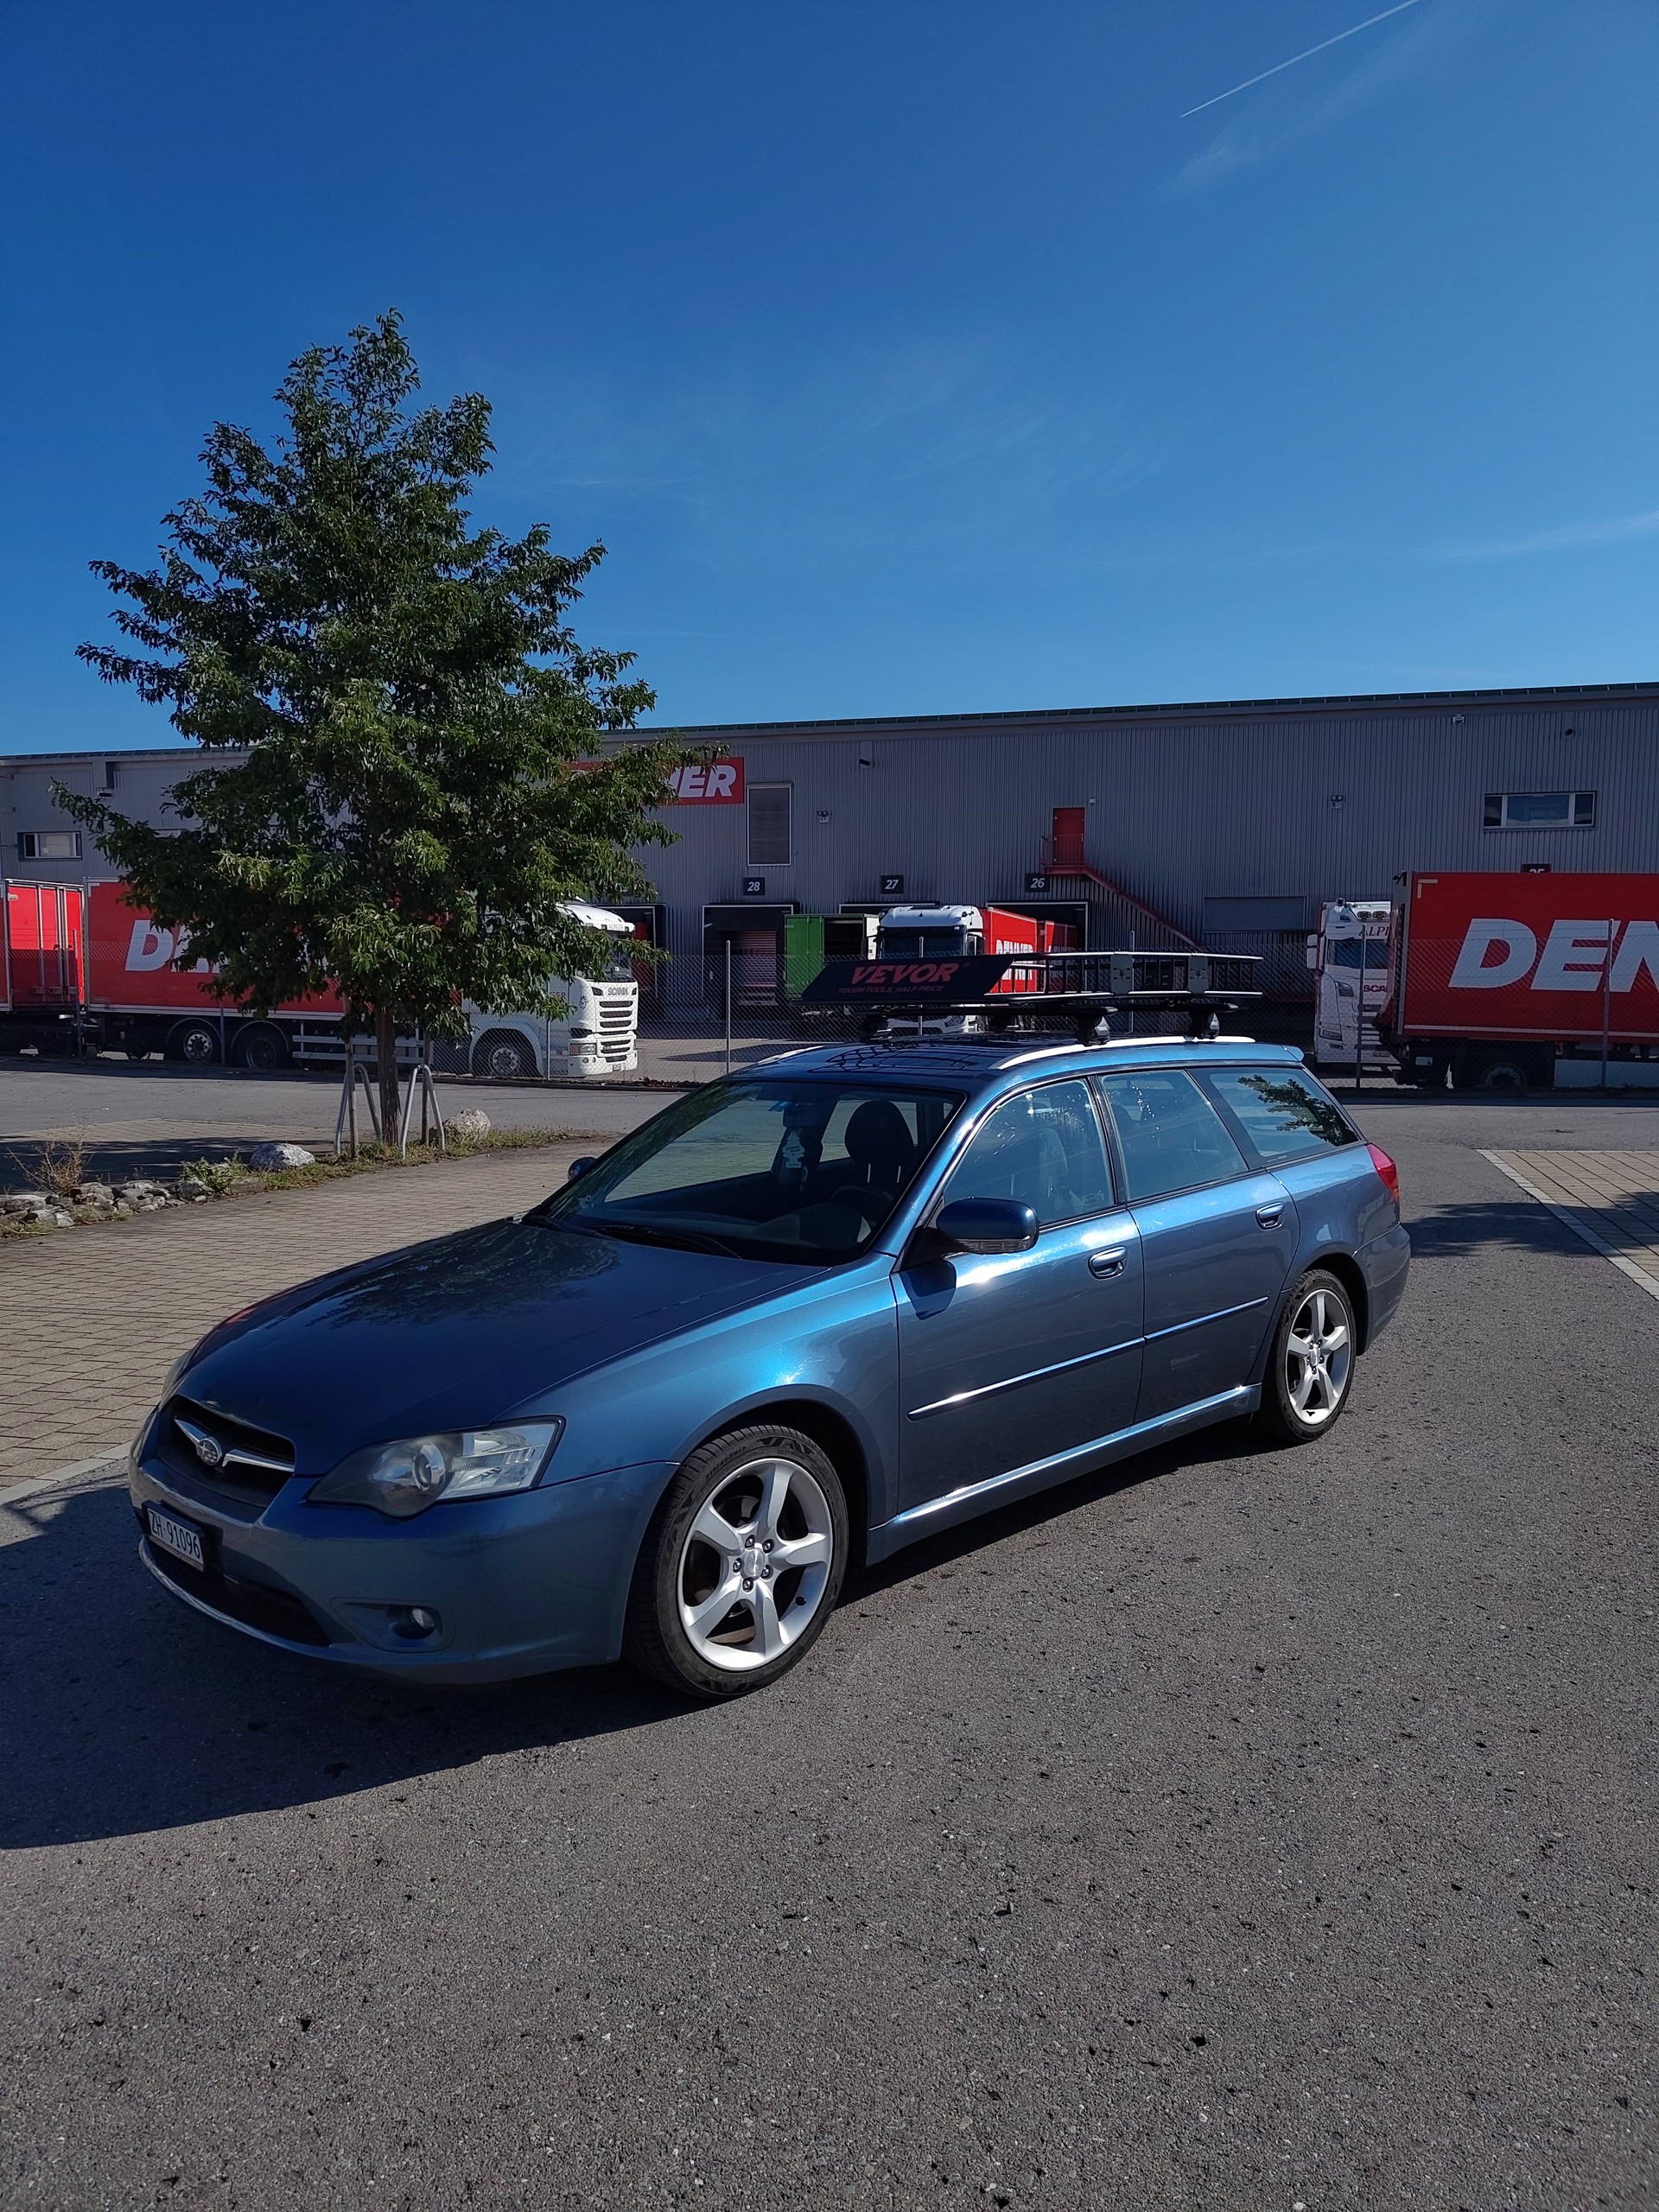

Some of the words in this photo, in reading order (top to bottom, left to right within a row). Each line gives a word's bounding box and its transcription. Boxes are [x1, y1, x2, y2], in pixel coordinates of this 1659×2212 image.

[747, 881, 760, 892] 28
[884, 879, 899, 890] 27
[1030, 877, 1046, 888] 26
[851, 963, 959, 984] VEVOR
